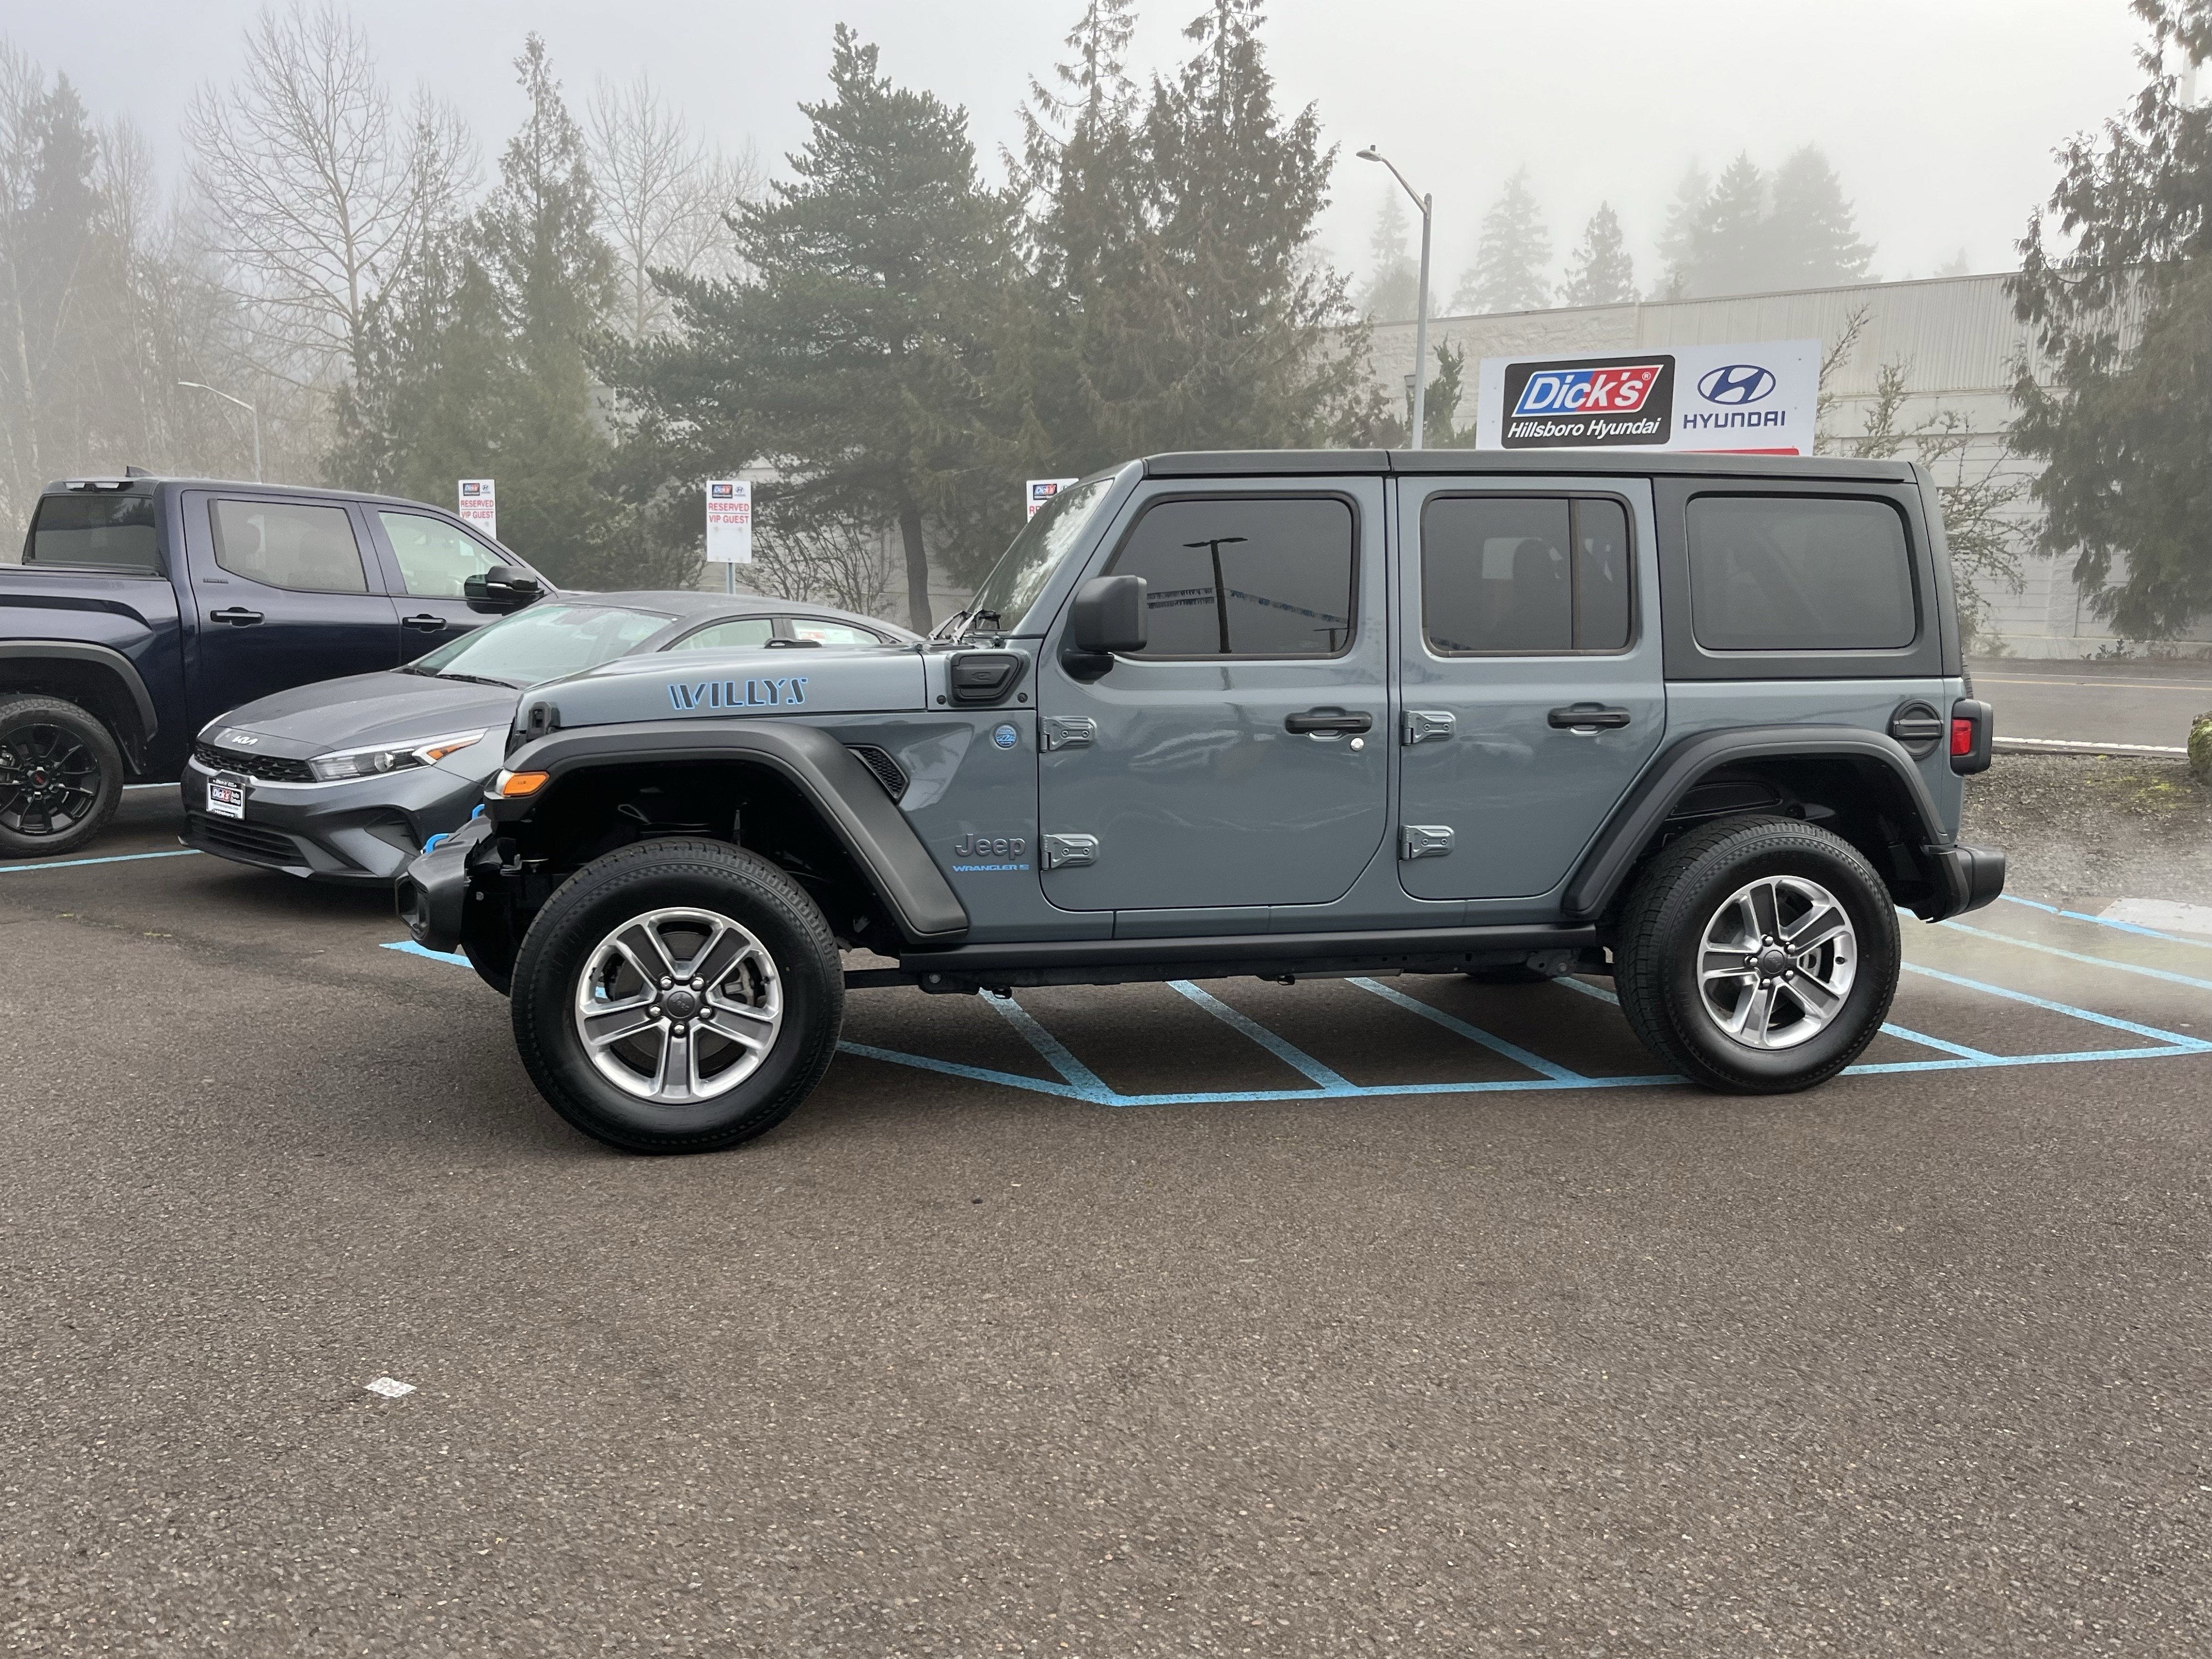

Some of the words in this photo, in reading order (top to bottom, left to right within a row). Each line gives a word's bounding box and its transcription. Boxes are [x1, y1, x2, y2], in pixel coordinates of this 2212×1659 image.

[1523, 372, 1644, 410] Dick's
[1508, 421, 1583, 439] Hillsboro
[1586, 417, 1662, 439] Hyundai
[1683, 411, 1785, 430] HYUNDAI
[708, 503, 749, 512] RESERVED
[723, 515, 749, 523] GUEST
[668, 678, 808, 709] WILLYS
[232, 735, 258, 746] KIA
[955, 833, 1025, 860] Jeep
